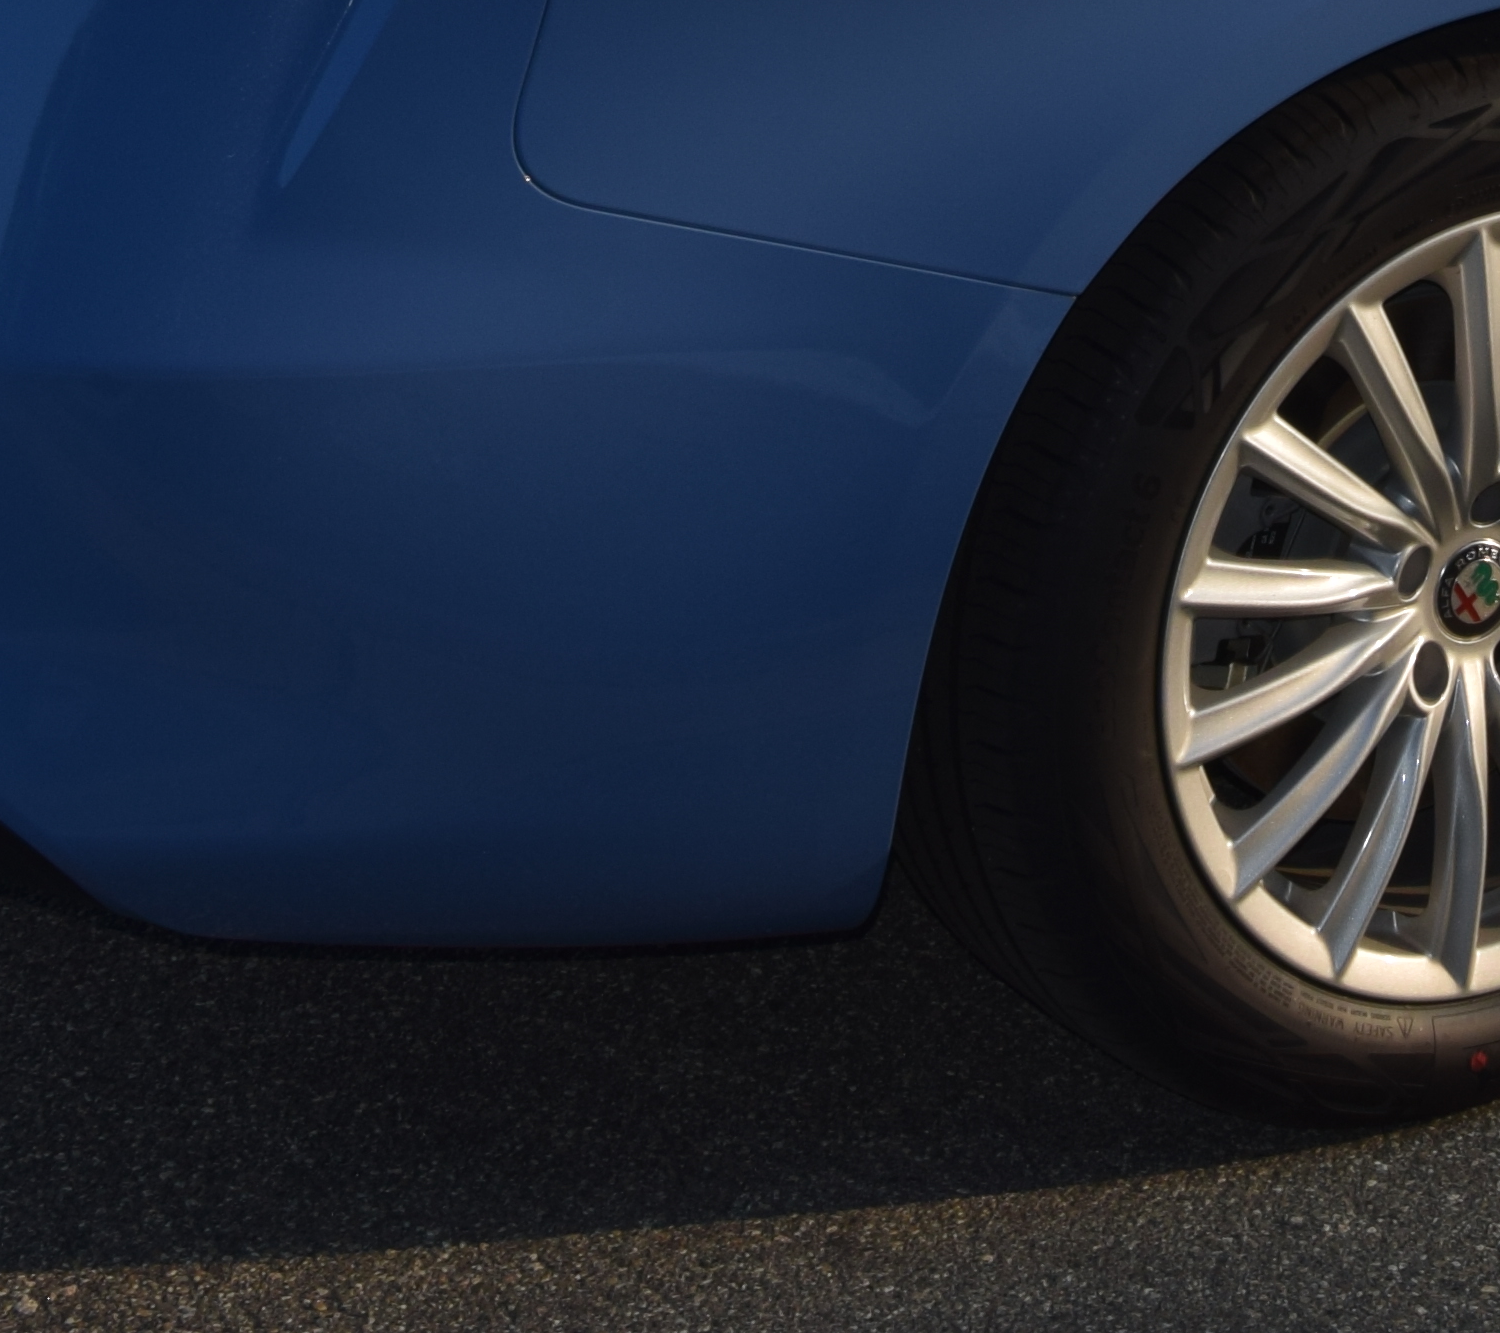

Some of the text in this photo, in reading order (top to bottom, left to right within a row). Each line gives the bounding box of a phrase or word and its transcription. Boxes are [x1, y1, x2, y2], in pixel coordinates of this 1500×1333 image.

[1442, 577, 1454, 618] ALFA
[1297, 1002, 1345, 1030] WARNING
[1353, 1020, 1394, 1039] SAFETY
